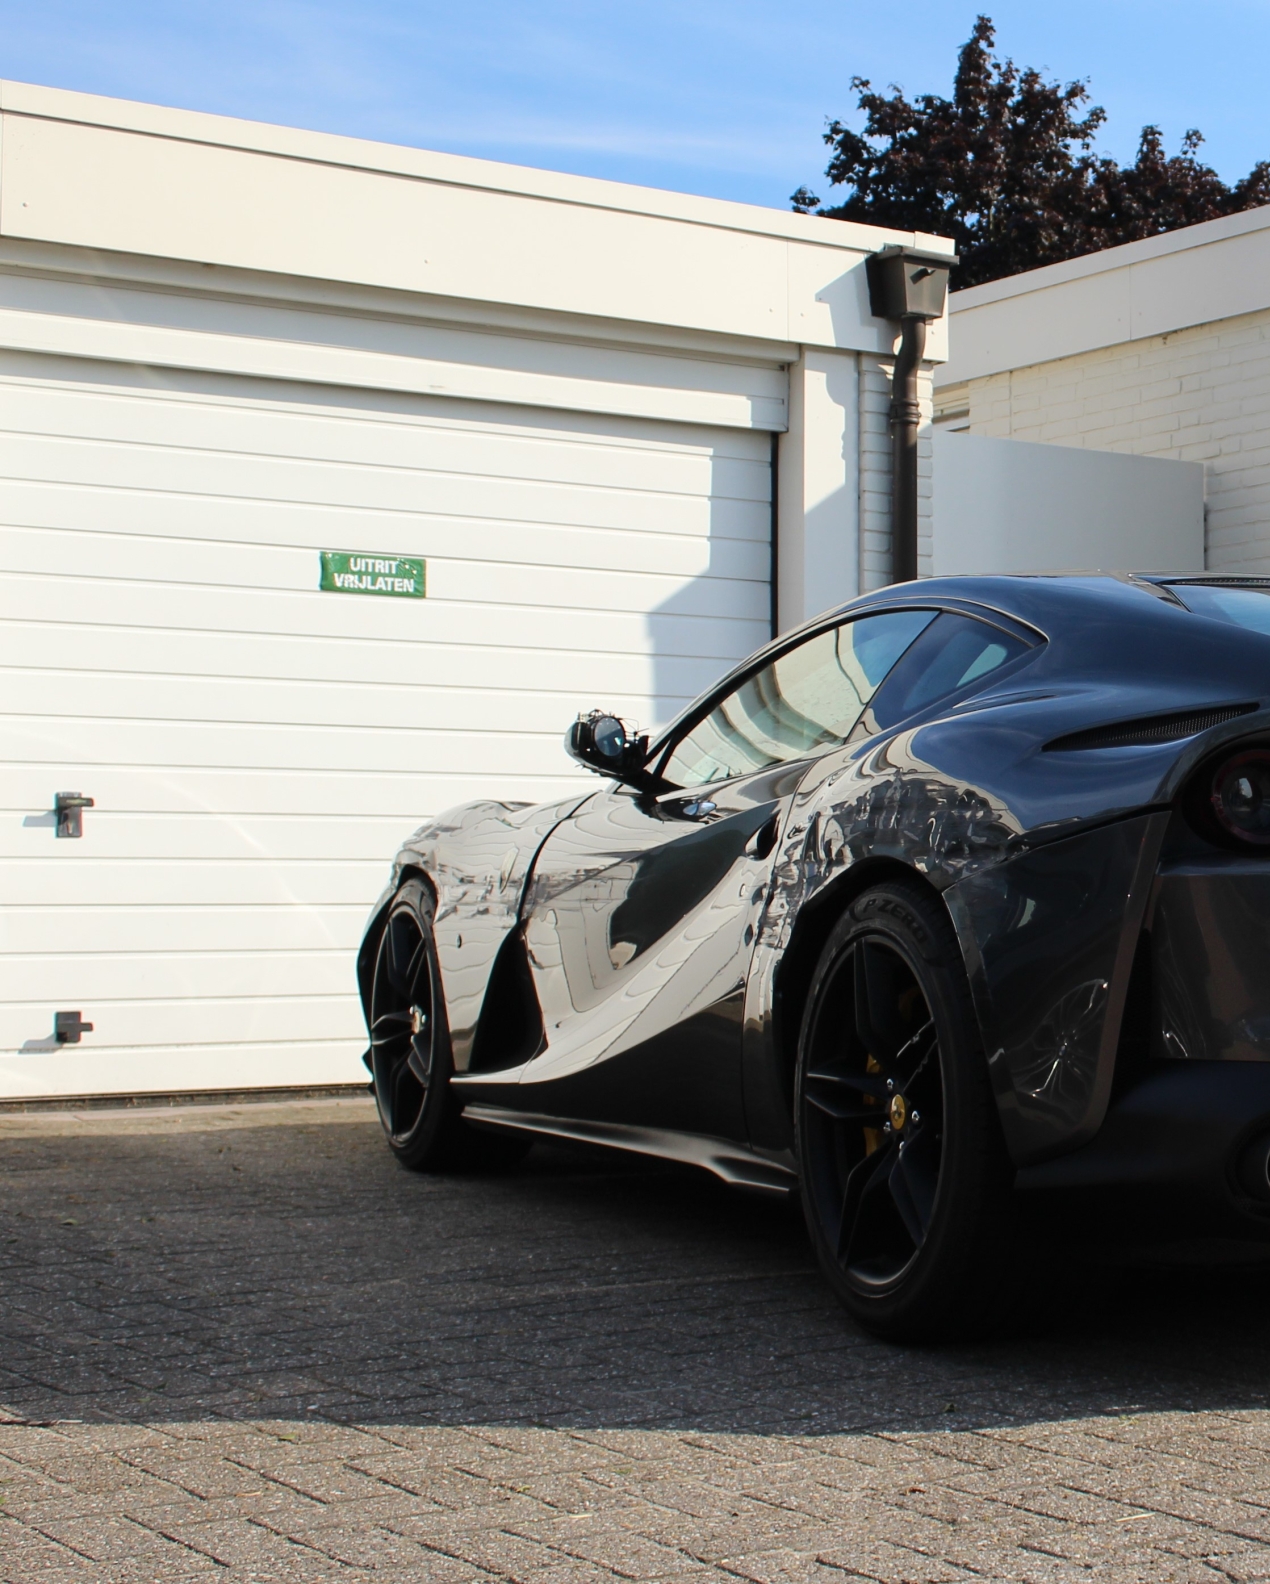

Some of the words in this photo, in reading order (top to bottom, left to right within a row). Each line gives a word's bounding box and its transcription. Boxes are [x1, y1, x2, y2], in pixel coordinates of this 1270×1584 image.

[349, 557, 398, 574] UITRIT
[333, 572, 415, 593] VRIJLATEN
[878, 900, 928, 944] ZERO
